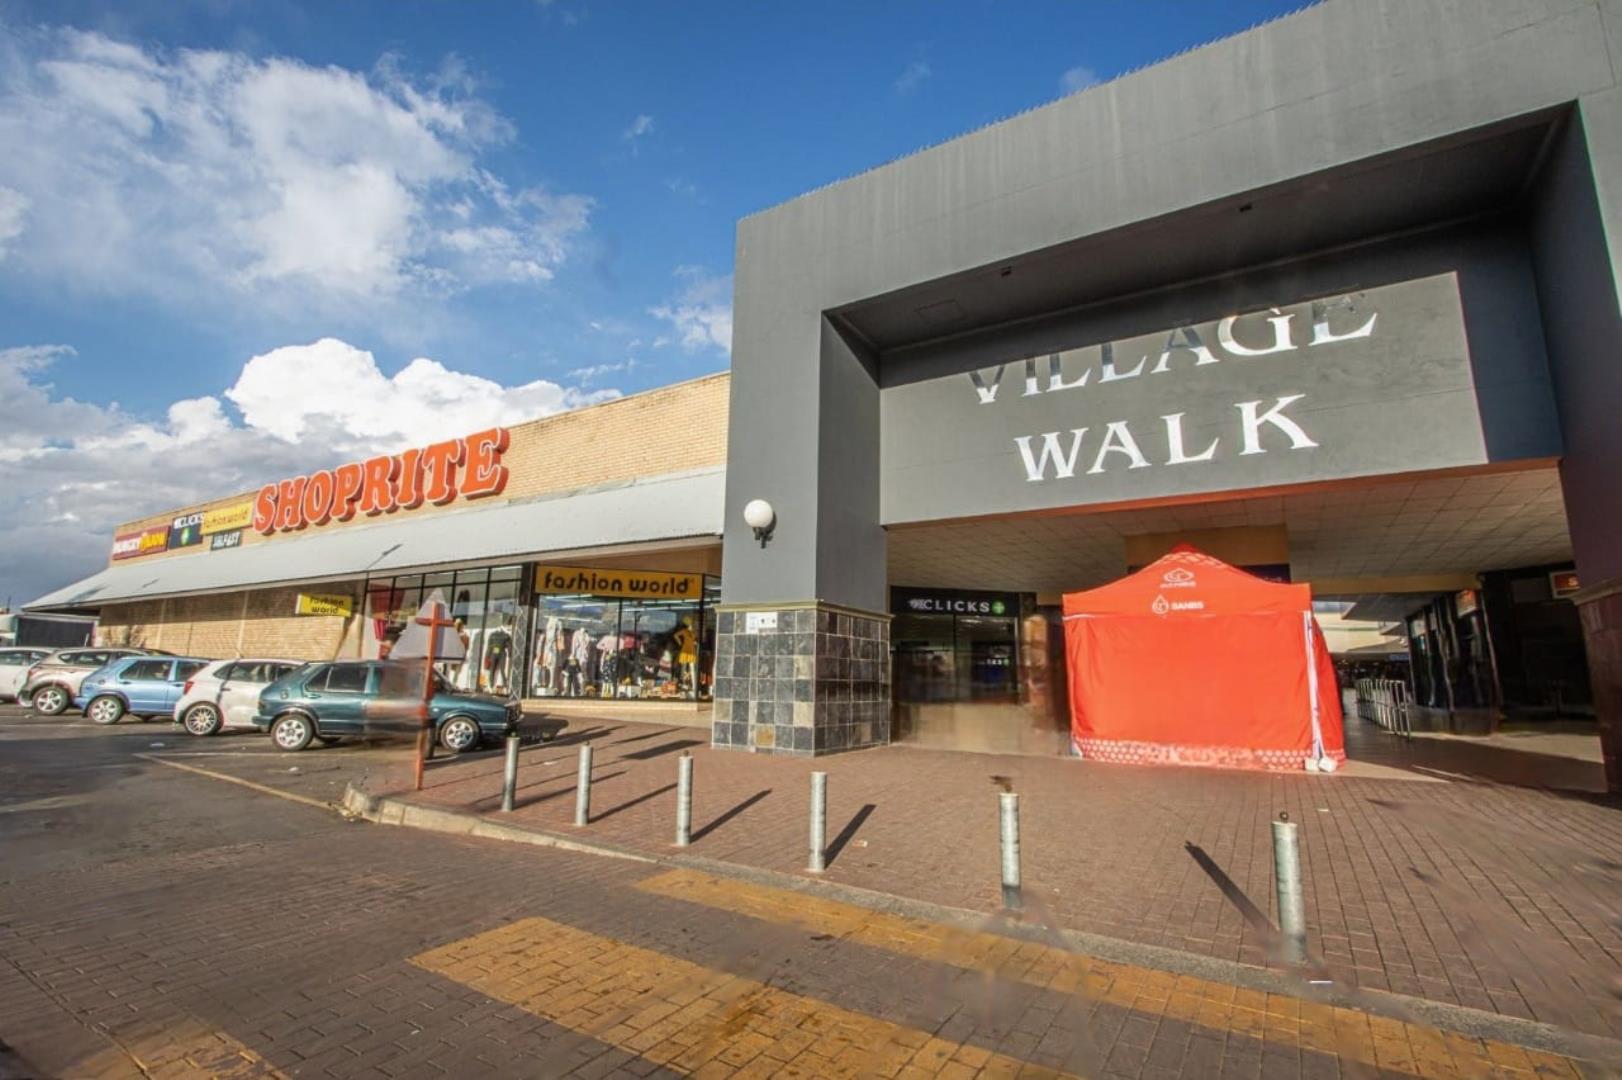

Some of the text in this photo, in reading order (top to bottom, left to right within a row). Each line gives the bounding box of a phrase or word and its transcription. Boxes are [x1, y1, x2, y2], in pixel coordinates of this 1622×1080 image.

[969, 294, 1378, 405] VILLAGE
[1013, 393, 1319, 482] WALK
[253, 427, 509, 535] SHOPRITE
[544, 571, 690, 595] fashion world
[310, 596, 345, 608] fashion
[311, 605, 339, 614] world
[923, 599, 991, 613] CLICKS
